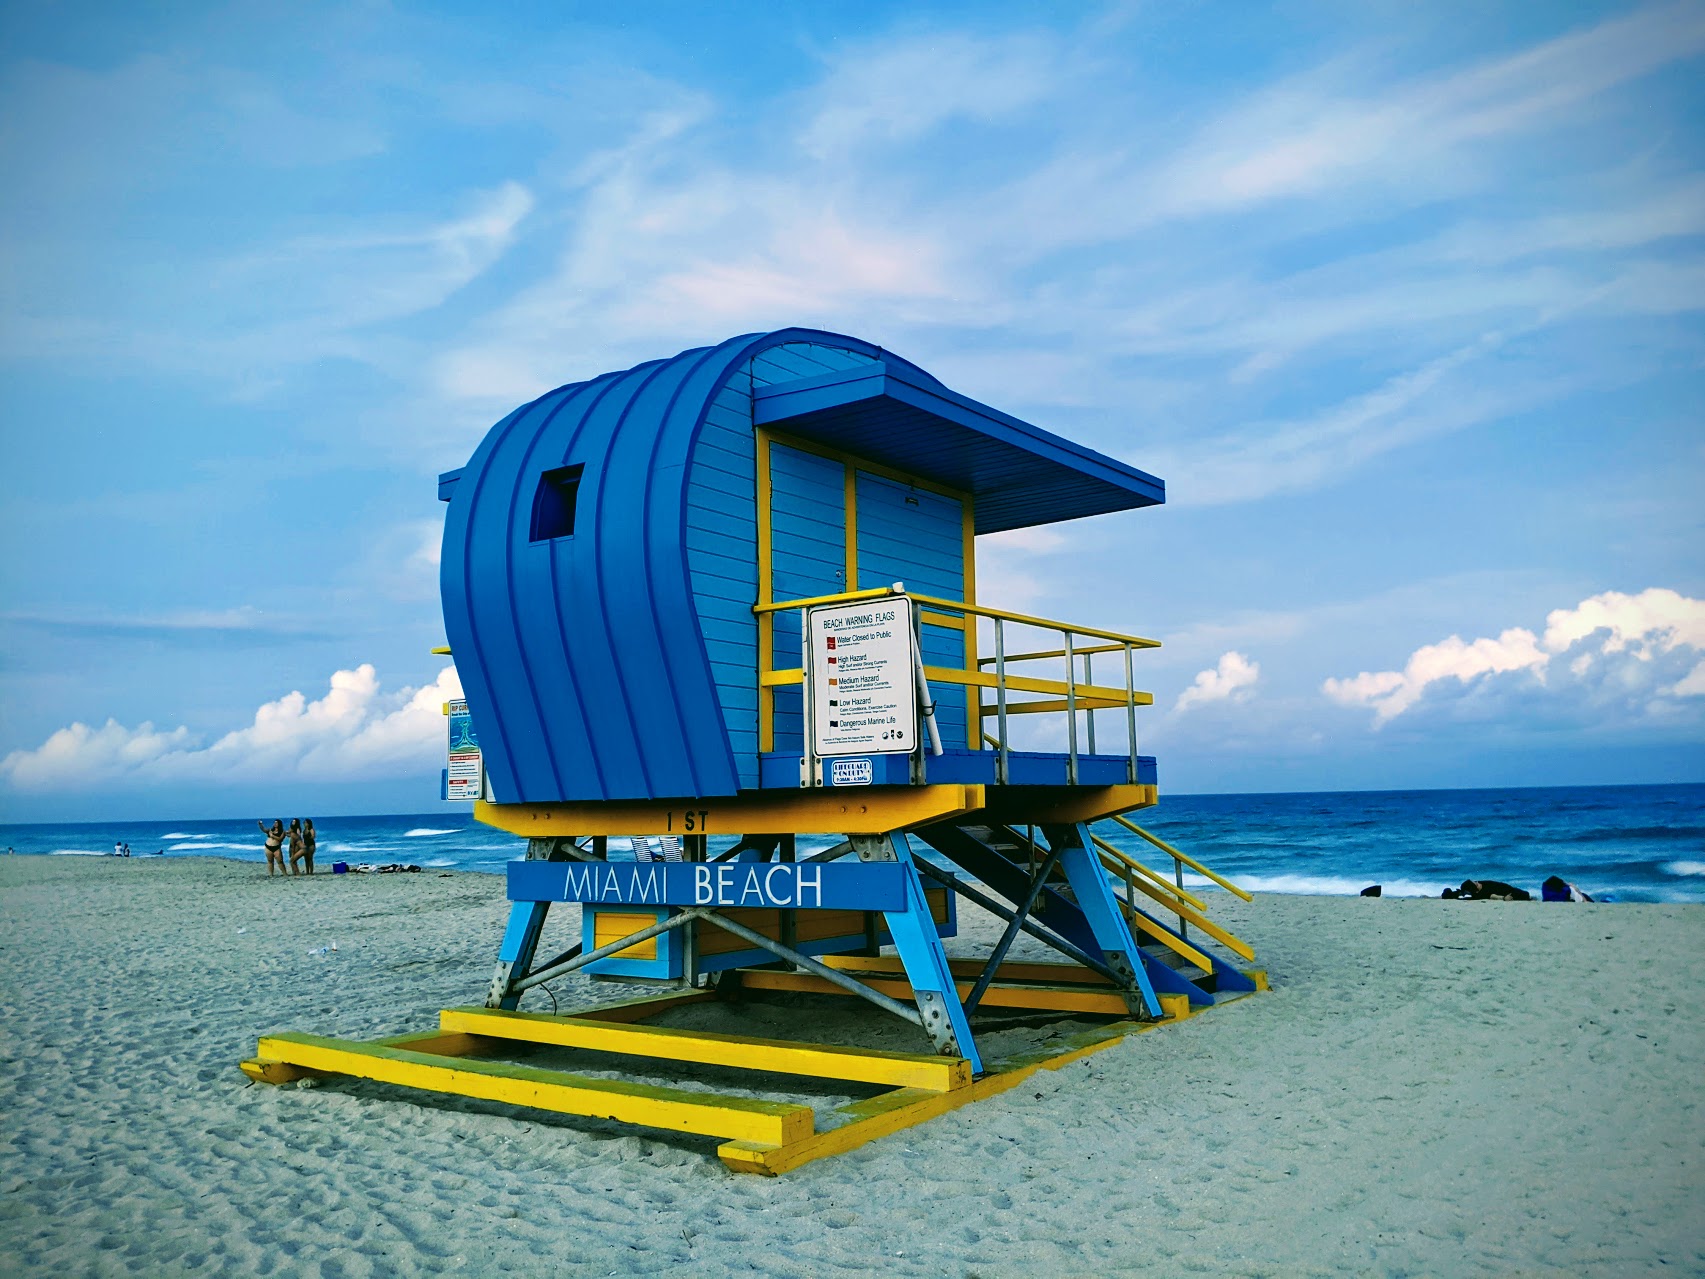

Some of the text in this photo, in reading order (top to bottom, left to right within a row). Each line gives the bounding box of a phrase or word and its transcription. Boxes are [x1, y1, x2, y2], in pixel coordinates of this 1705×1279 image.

[824, 618, 843, 629] BEACH
[845, 614, 872, 626] WARNING
[876, 611, 895, 622] FLAGS
[852, 633, 869, 641] Closed
[876, 631, 892, 639] Public
[838, 654, 867, 664] High Hazard
[840, 720, 866, 728] Dangerous
[684, 811, 709, 831] ST
[563, 864, 821, 906] MIAMI BEACH
